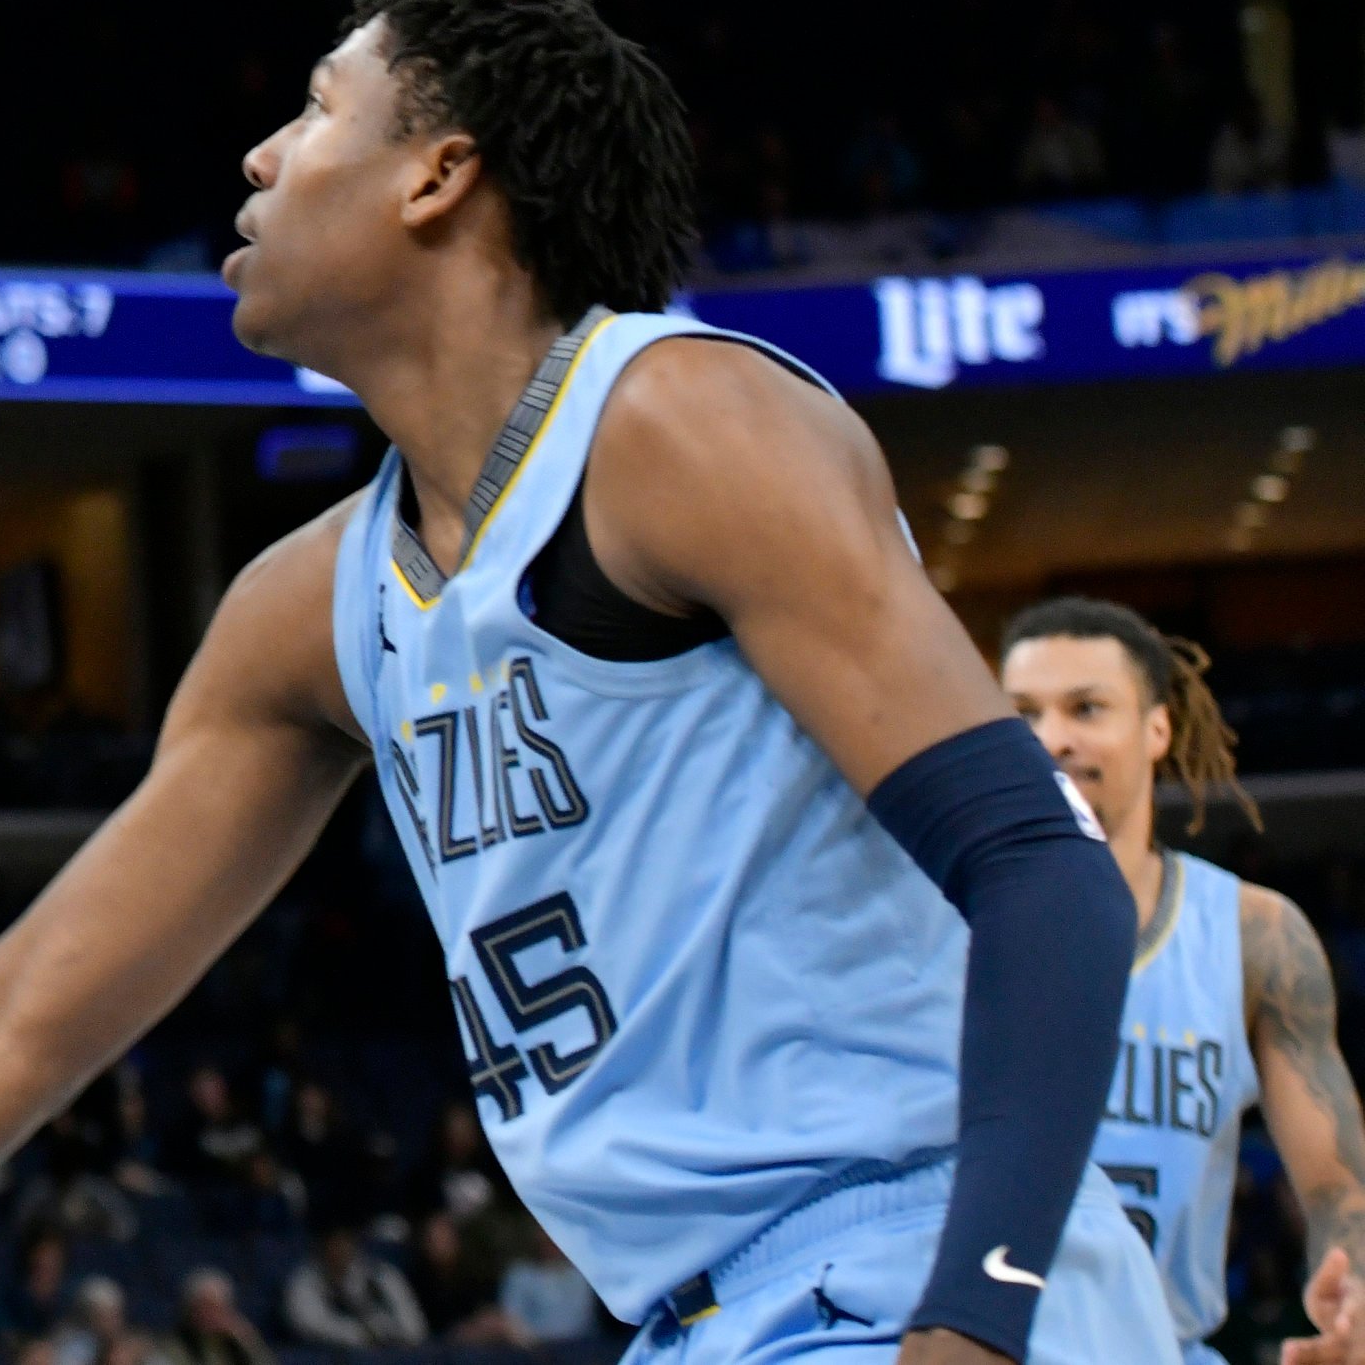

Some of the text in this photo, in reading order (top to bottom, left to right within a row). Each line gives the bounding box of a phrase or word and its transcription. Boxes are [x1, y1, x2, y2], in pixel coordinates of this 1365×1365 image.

[872, 274, 1045, 389] Lite
[447, 891, 619, 1123] 45
[1099, 1039, 1223, 1138] LIES
